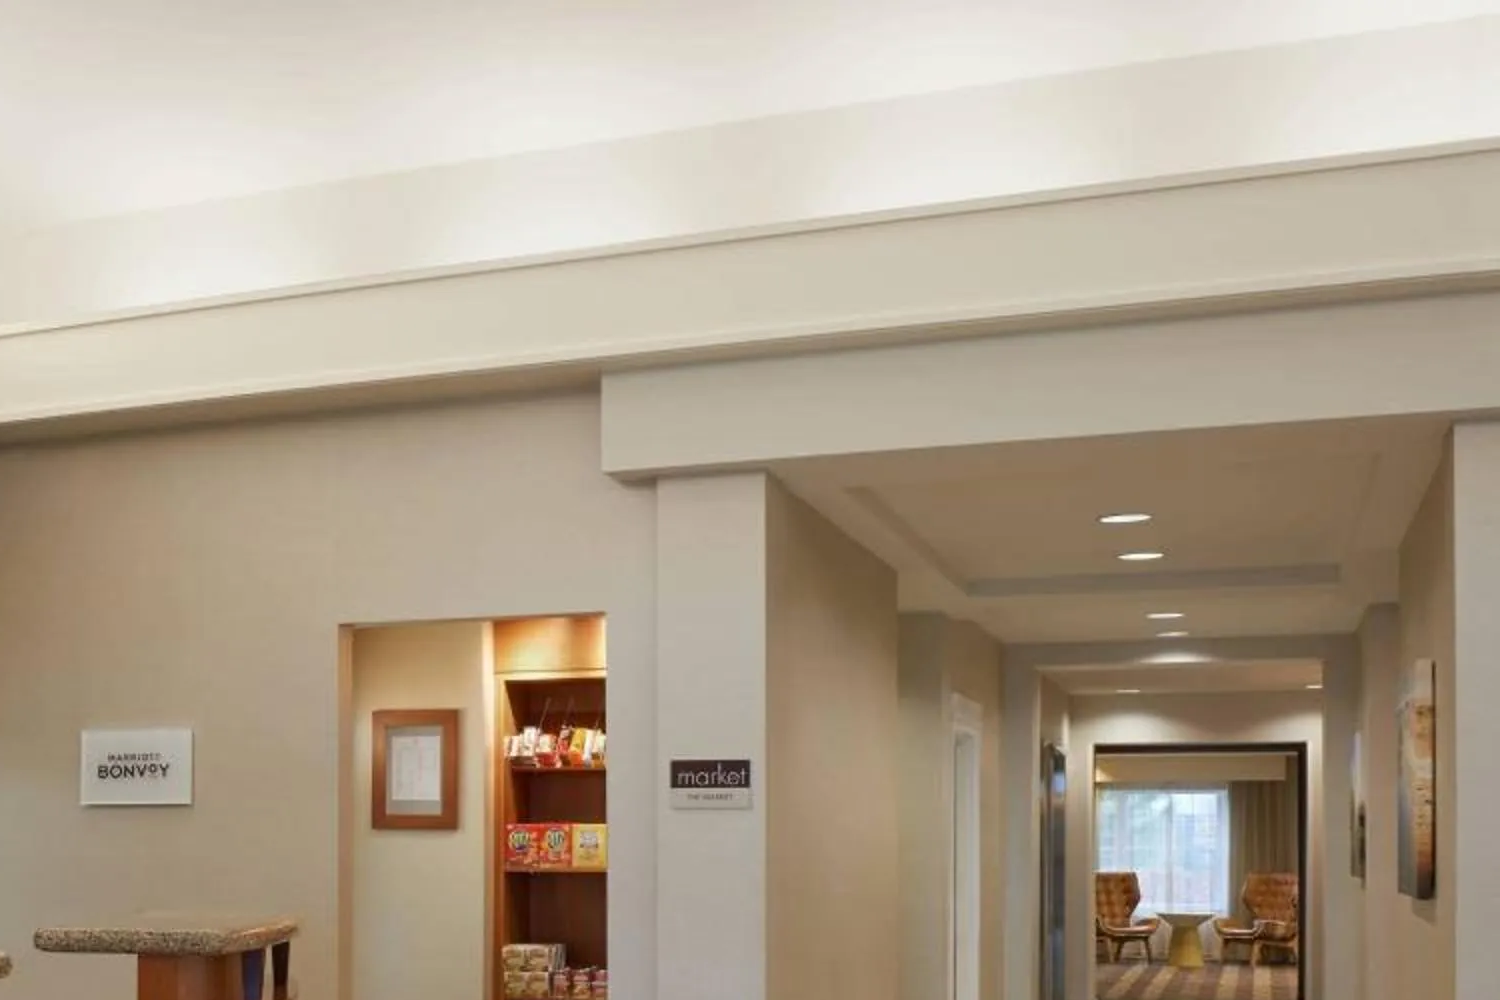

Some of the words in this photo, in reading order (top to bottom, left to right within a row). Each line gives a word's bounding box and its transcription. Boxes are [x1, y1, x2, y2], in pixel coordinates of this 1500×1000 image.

[107, 752, 160, 761] MARRIOTT
[97, 763, 169, 779] BONVOY
[677, 762, 746, 785] market
